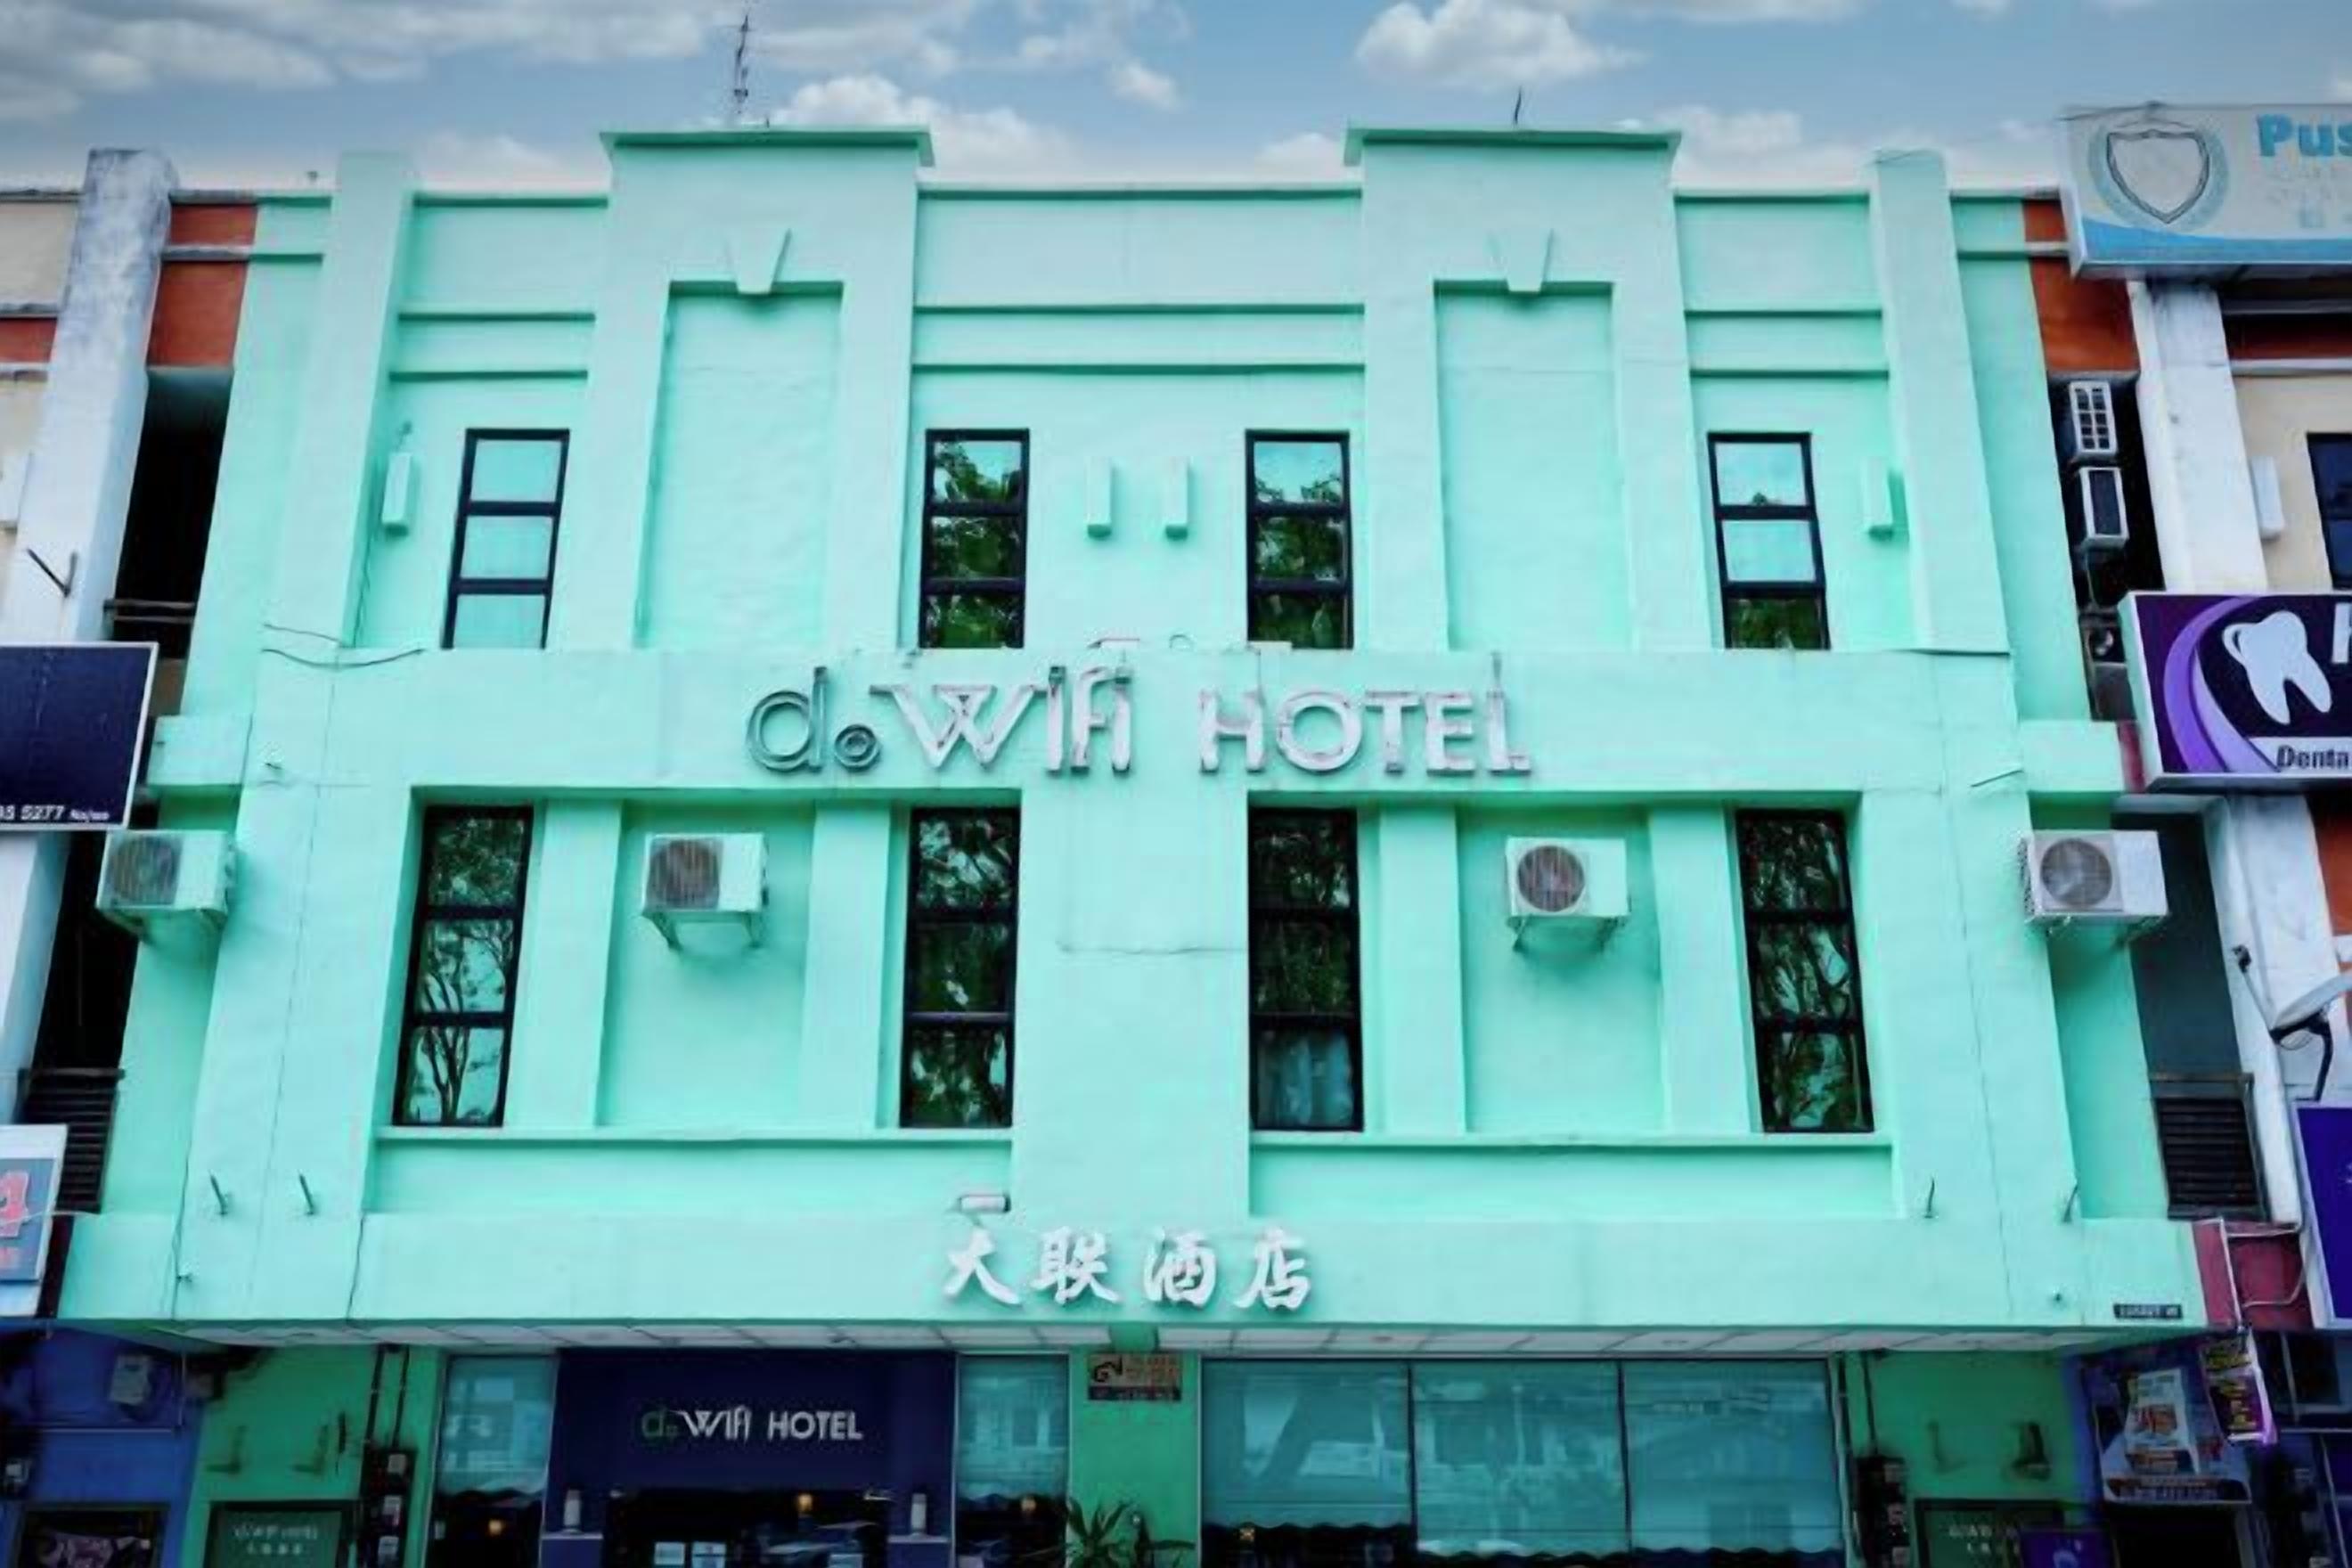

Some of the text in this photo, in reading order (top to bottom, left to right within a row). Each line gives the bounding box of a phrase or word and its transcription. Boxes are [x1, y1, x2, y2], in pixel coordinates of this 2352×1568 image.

[1199, 690, 1531, 774] HOTEL
[944, 1226, 1312, 1310] 大联酒店
[768, 1410, 862, 1441] HOTEL
